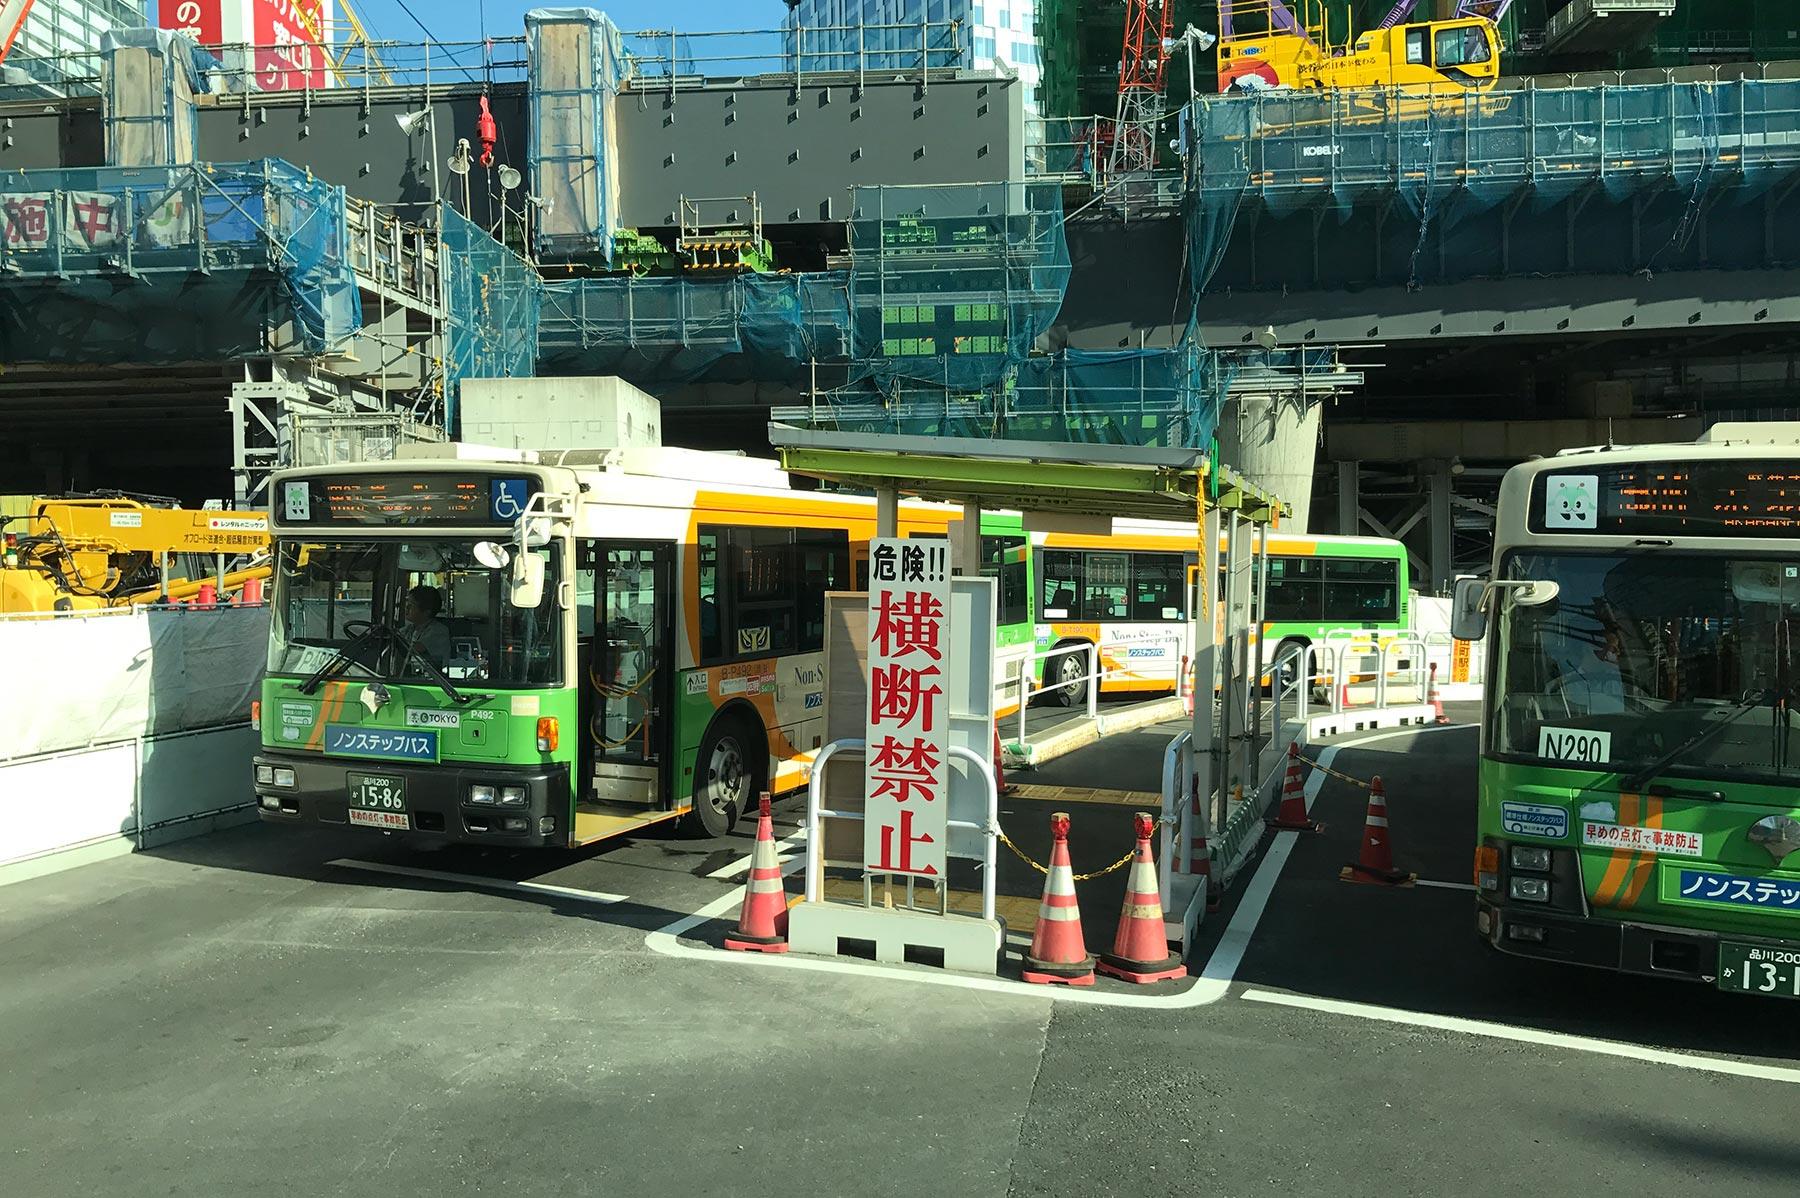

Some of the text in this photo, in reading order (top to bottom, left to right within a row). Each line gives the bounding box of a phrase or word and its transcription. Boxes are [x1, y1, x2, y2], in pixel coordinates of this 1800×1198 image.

[694, 673, 707, 684] 入口
[429, 713, 458, 725] TOKYO
[470, 709, 495, 720] P492
[867, 589, 944, 876] 横断禁止
[333, 733, 430, 755] ノンステップバス
[1544, 733, 1602, 764] N290
[363, 777, 390, 787] 品川200
[361, 785, 403, 809] 15-86
[1585, 825, 1700, 850] 早めの点灯で事故防止
[1682, 876, 1800, 905] ノンステッ
[1722, 967, 1736, 978] か
